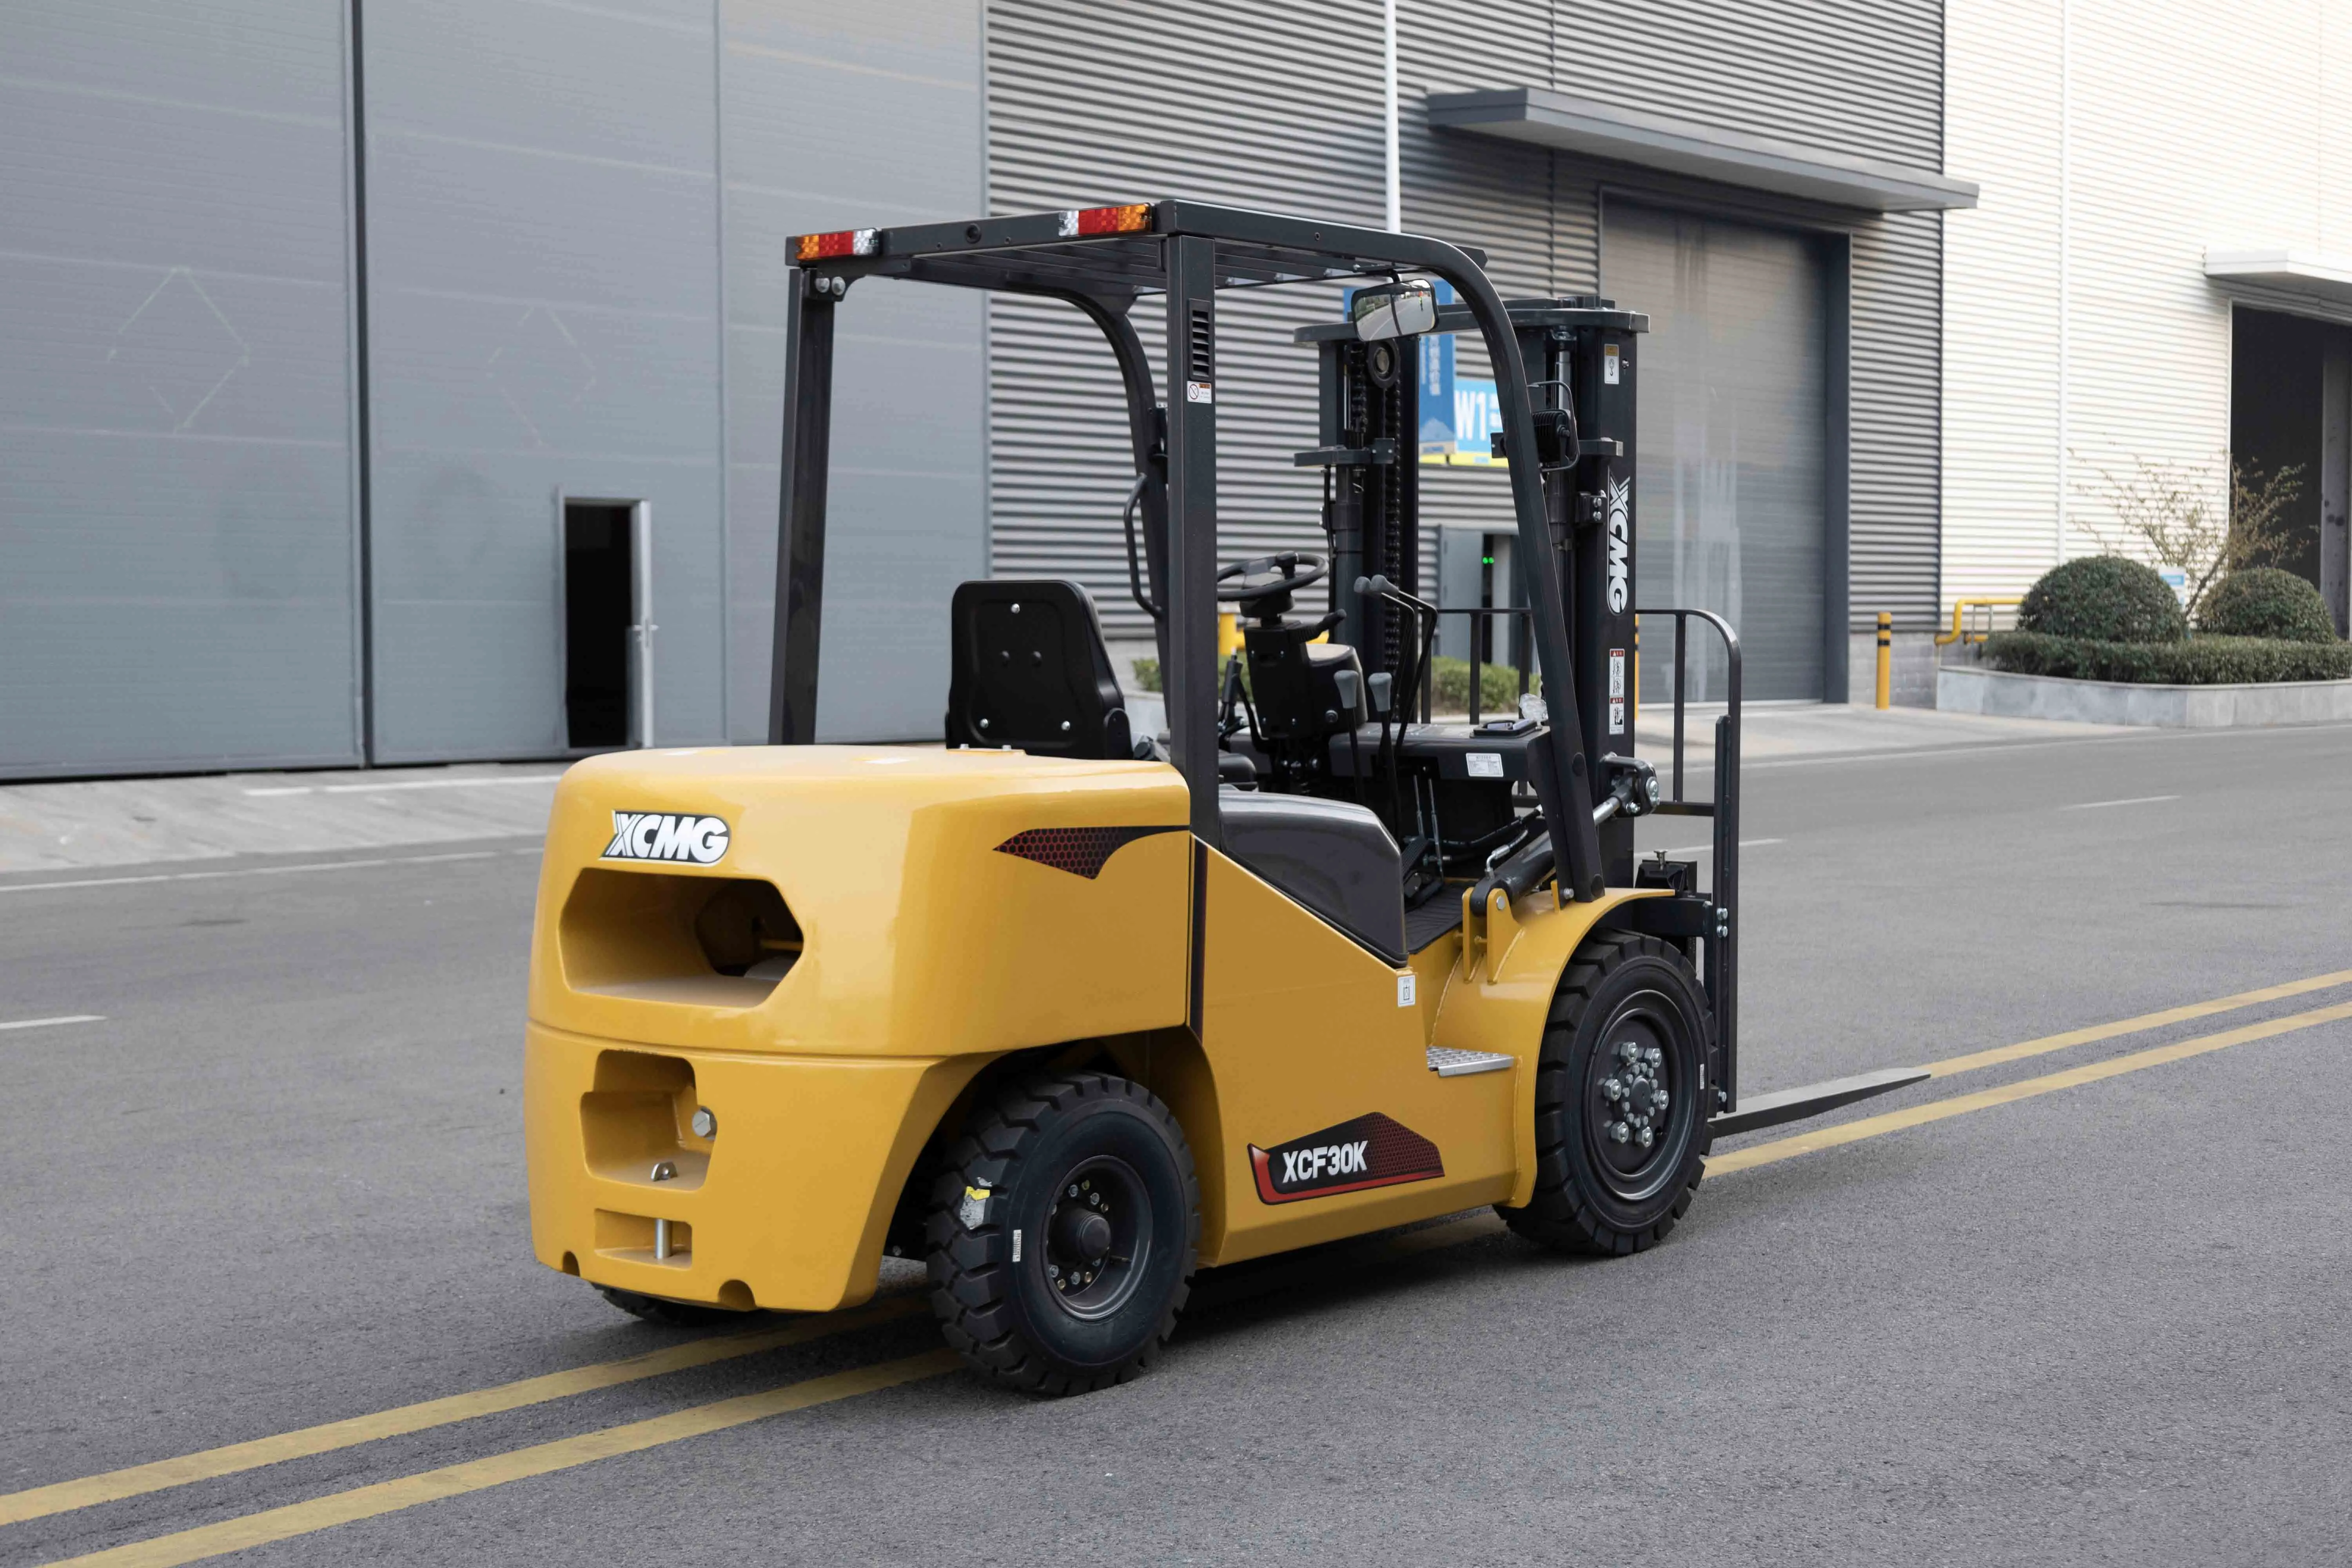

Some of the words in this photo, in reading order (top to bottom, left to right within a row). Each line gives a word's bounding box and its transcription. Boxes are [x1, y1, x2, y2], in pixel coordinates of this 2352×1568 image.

[1455, 390, 1487, 441] W1
[1609, 476, 1630, 614] XCMG
[606, 813, 728, 863] XCMG
[1282, 1140, 1368, 1183] XCF30K
